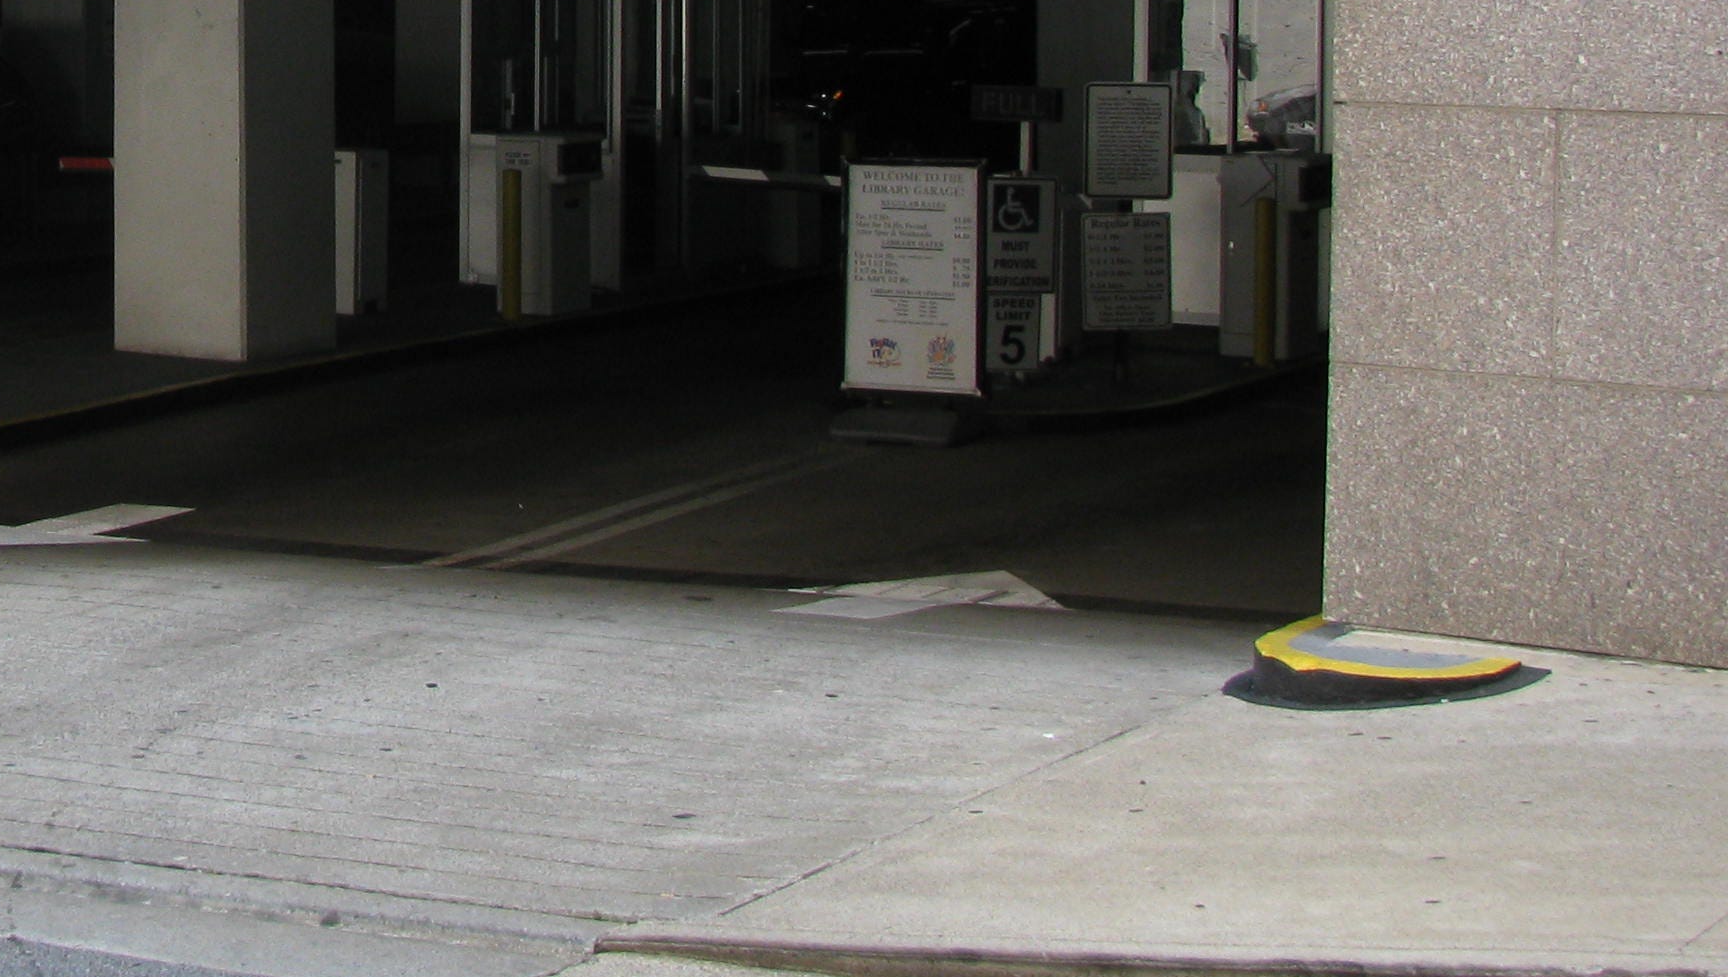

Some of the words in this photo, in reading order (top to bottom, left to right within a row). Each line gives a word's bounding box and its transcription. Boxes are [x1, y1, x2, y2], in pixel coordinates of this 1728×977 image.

[863, 170, 919, 182] WELCOME
[925, 171, 941, 182] TO
[1001, 240, 1030, 252] MUST
[993, 258, 1038, 269] PROVIDE
[987, 276, 1050, 287] ERIFICATION
[993, 297, 1035, 309] SPEED
[996, 311, 1031, 321] LIMIT
[1000, 324, 1026, 365] 5
